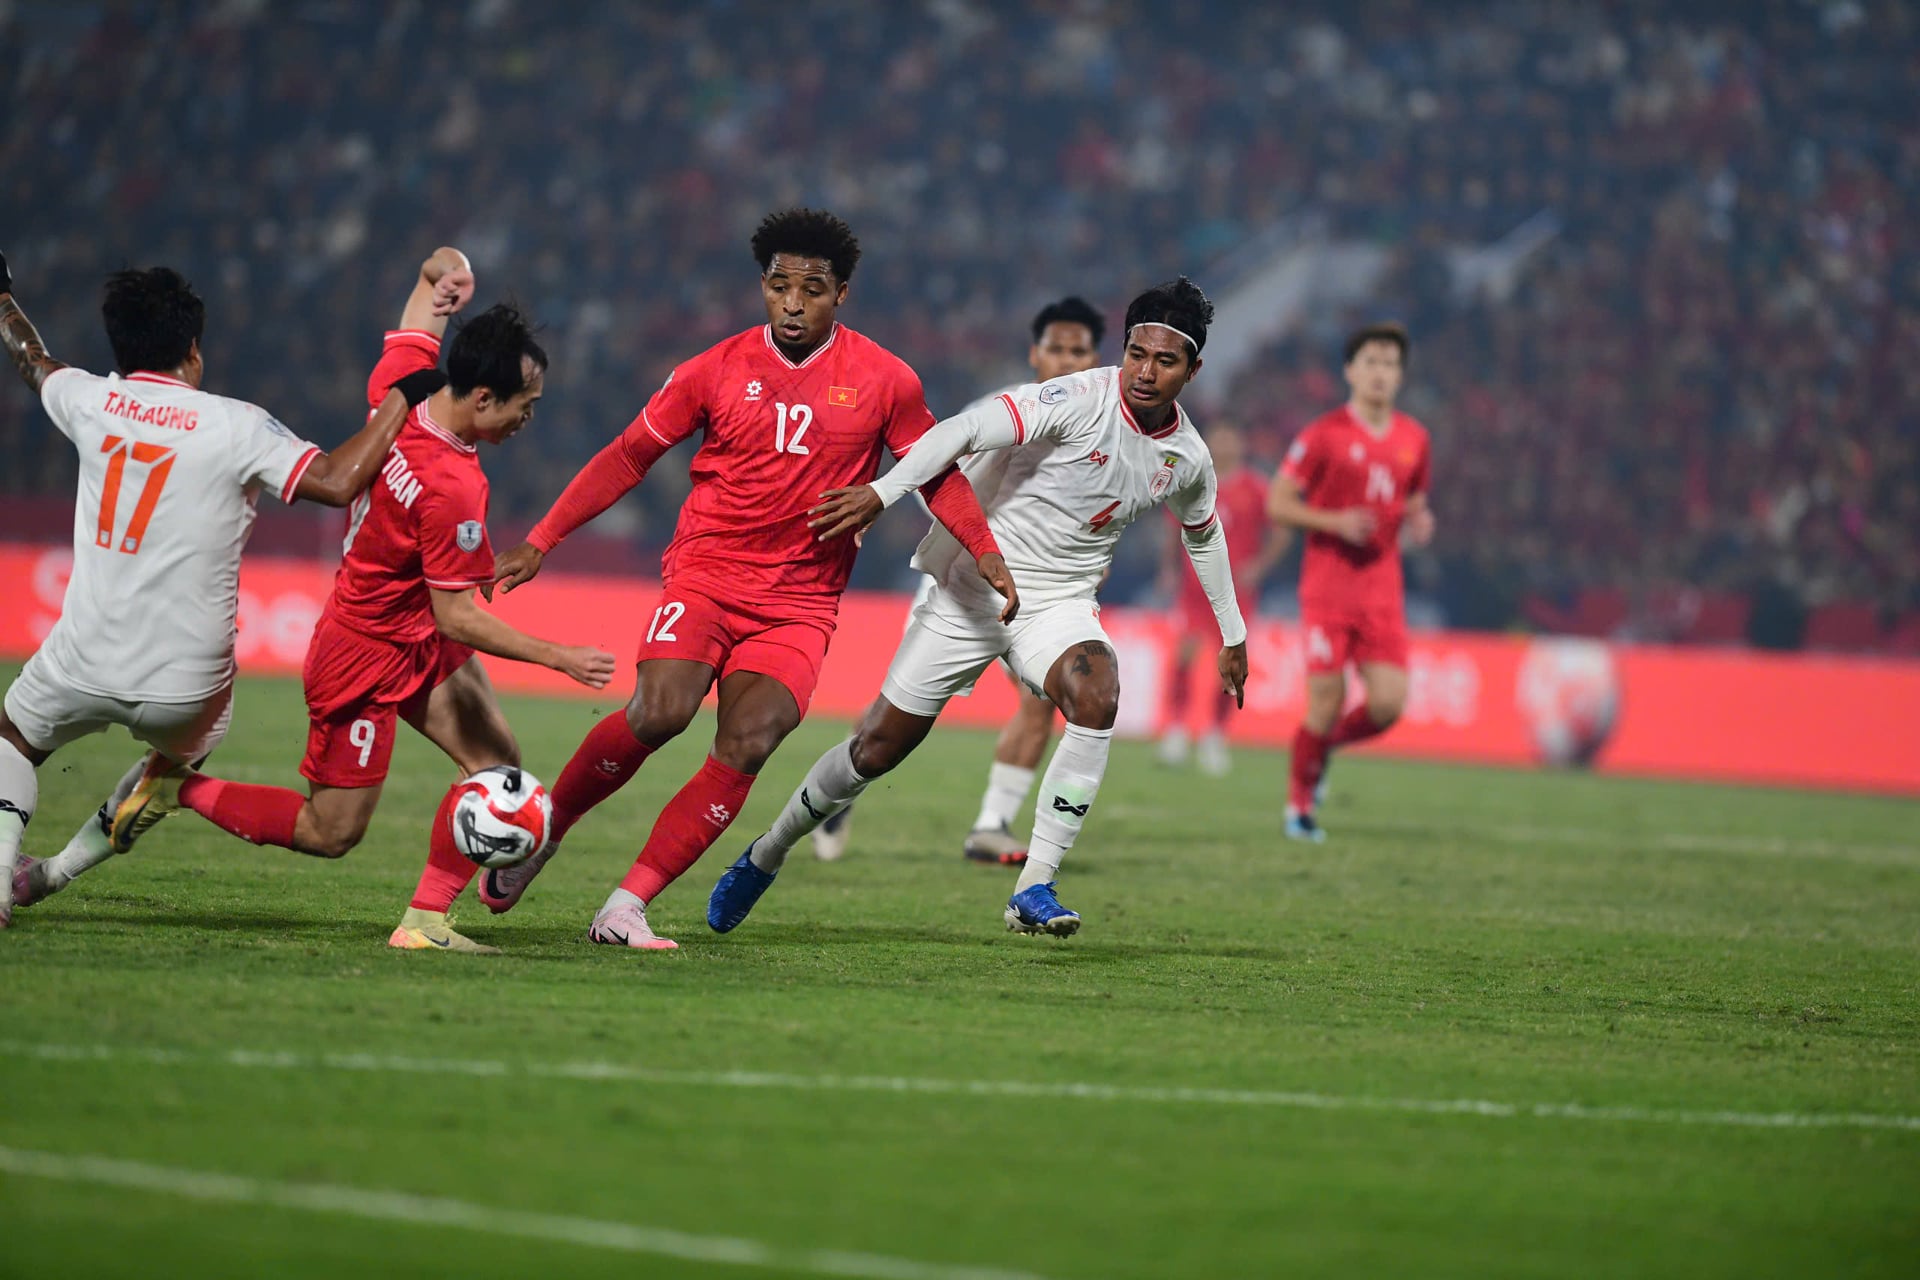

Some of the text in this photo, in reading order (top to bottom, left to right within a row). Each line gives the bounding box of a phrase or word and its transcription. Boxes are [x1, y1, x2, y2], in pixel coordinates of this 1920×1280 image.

[775, 402, 813, 455] 12
[96, 434, 178, 555] 17
[381, 446, 423, 509] TOAN
[1089, 500, 1122, 533] 4
[646, 601, 685, 643] 12
[350, 719, 375, 767] 9
